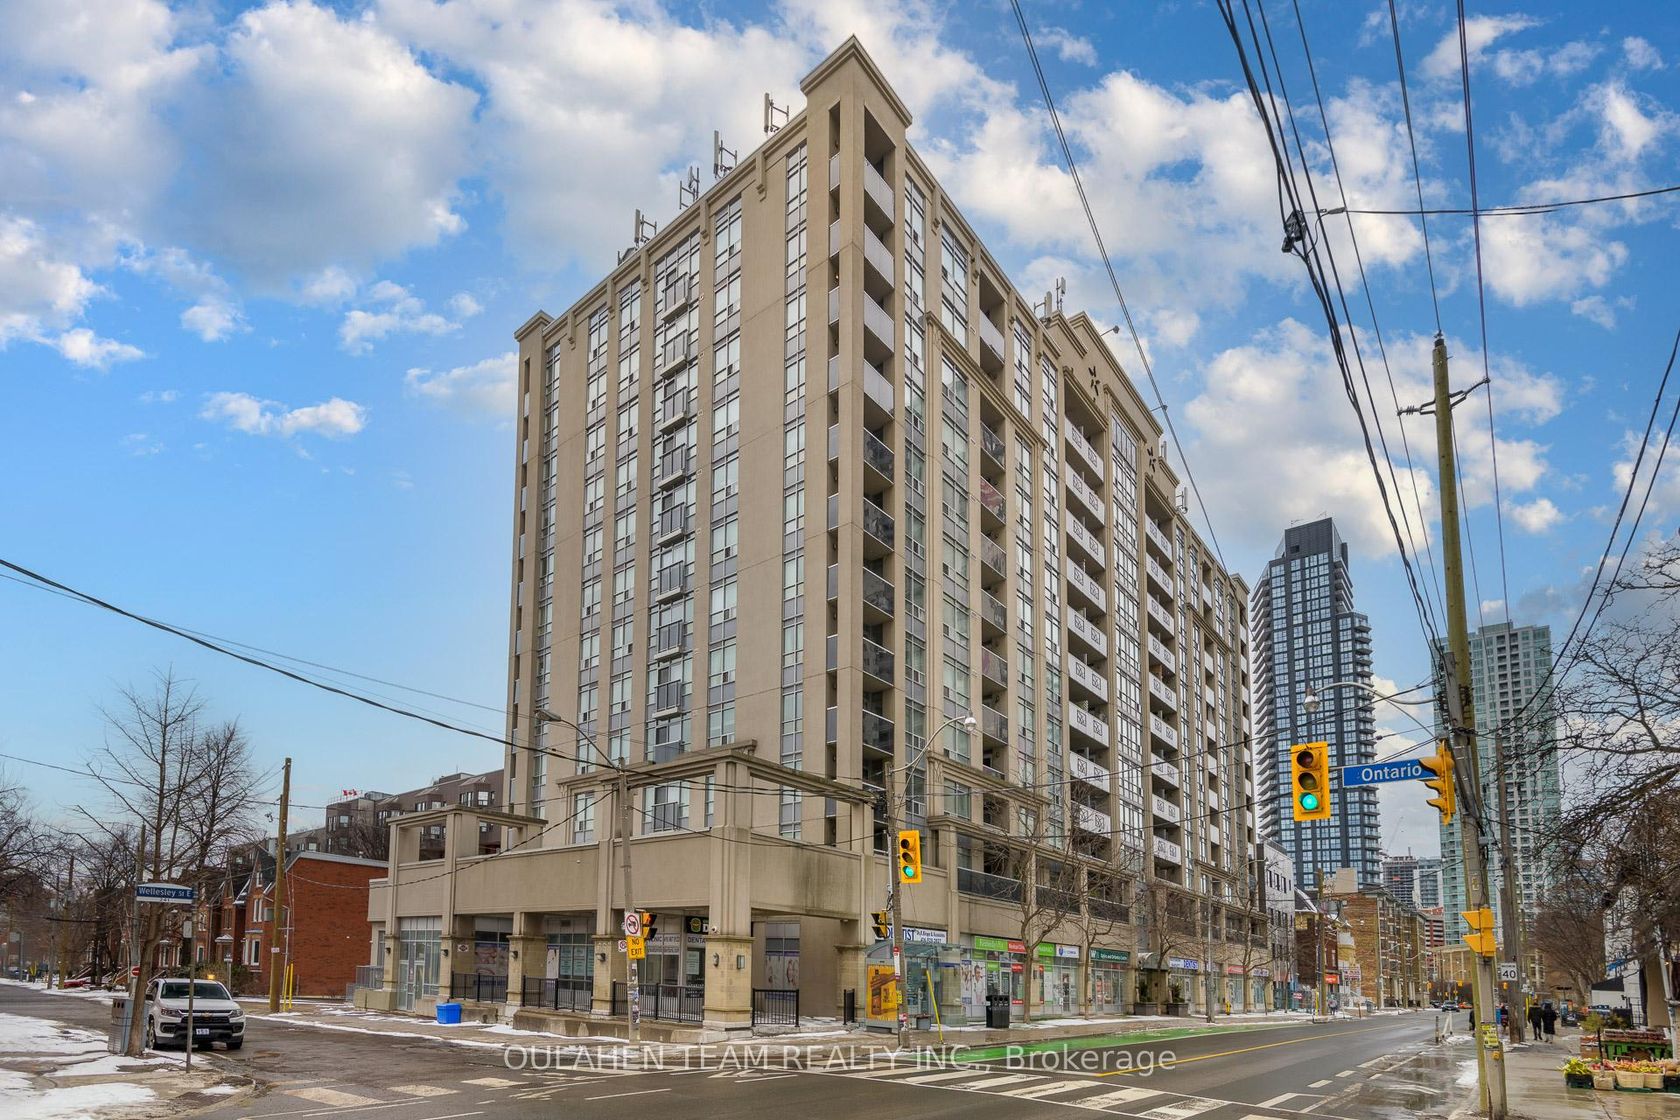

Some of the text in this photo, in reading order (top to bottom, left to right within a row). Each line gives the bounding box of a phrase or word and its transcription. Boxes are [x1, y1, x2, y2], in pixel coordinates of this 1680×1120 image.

[1361, 763, 1422, 782] Ontario
[139, 887, 176, 897] Wellesley
[630, 948, 643, 956] EXIT
[1502, 970, 1517, 979] 40
